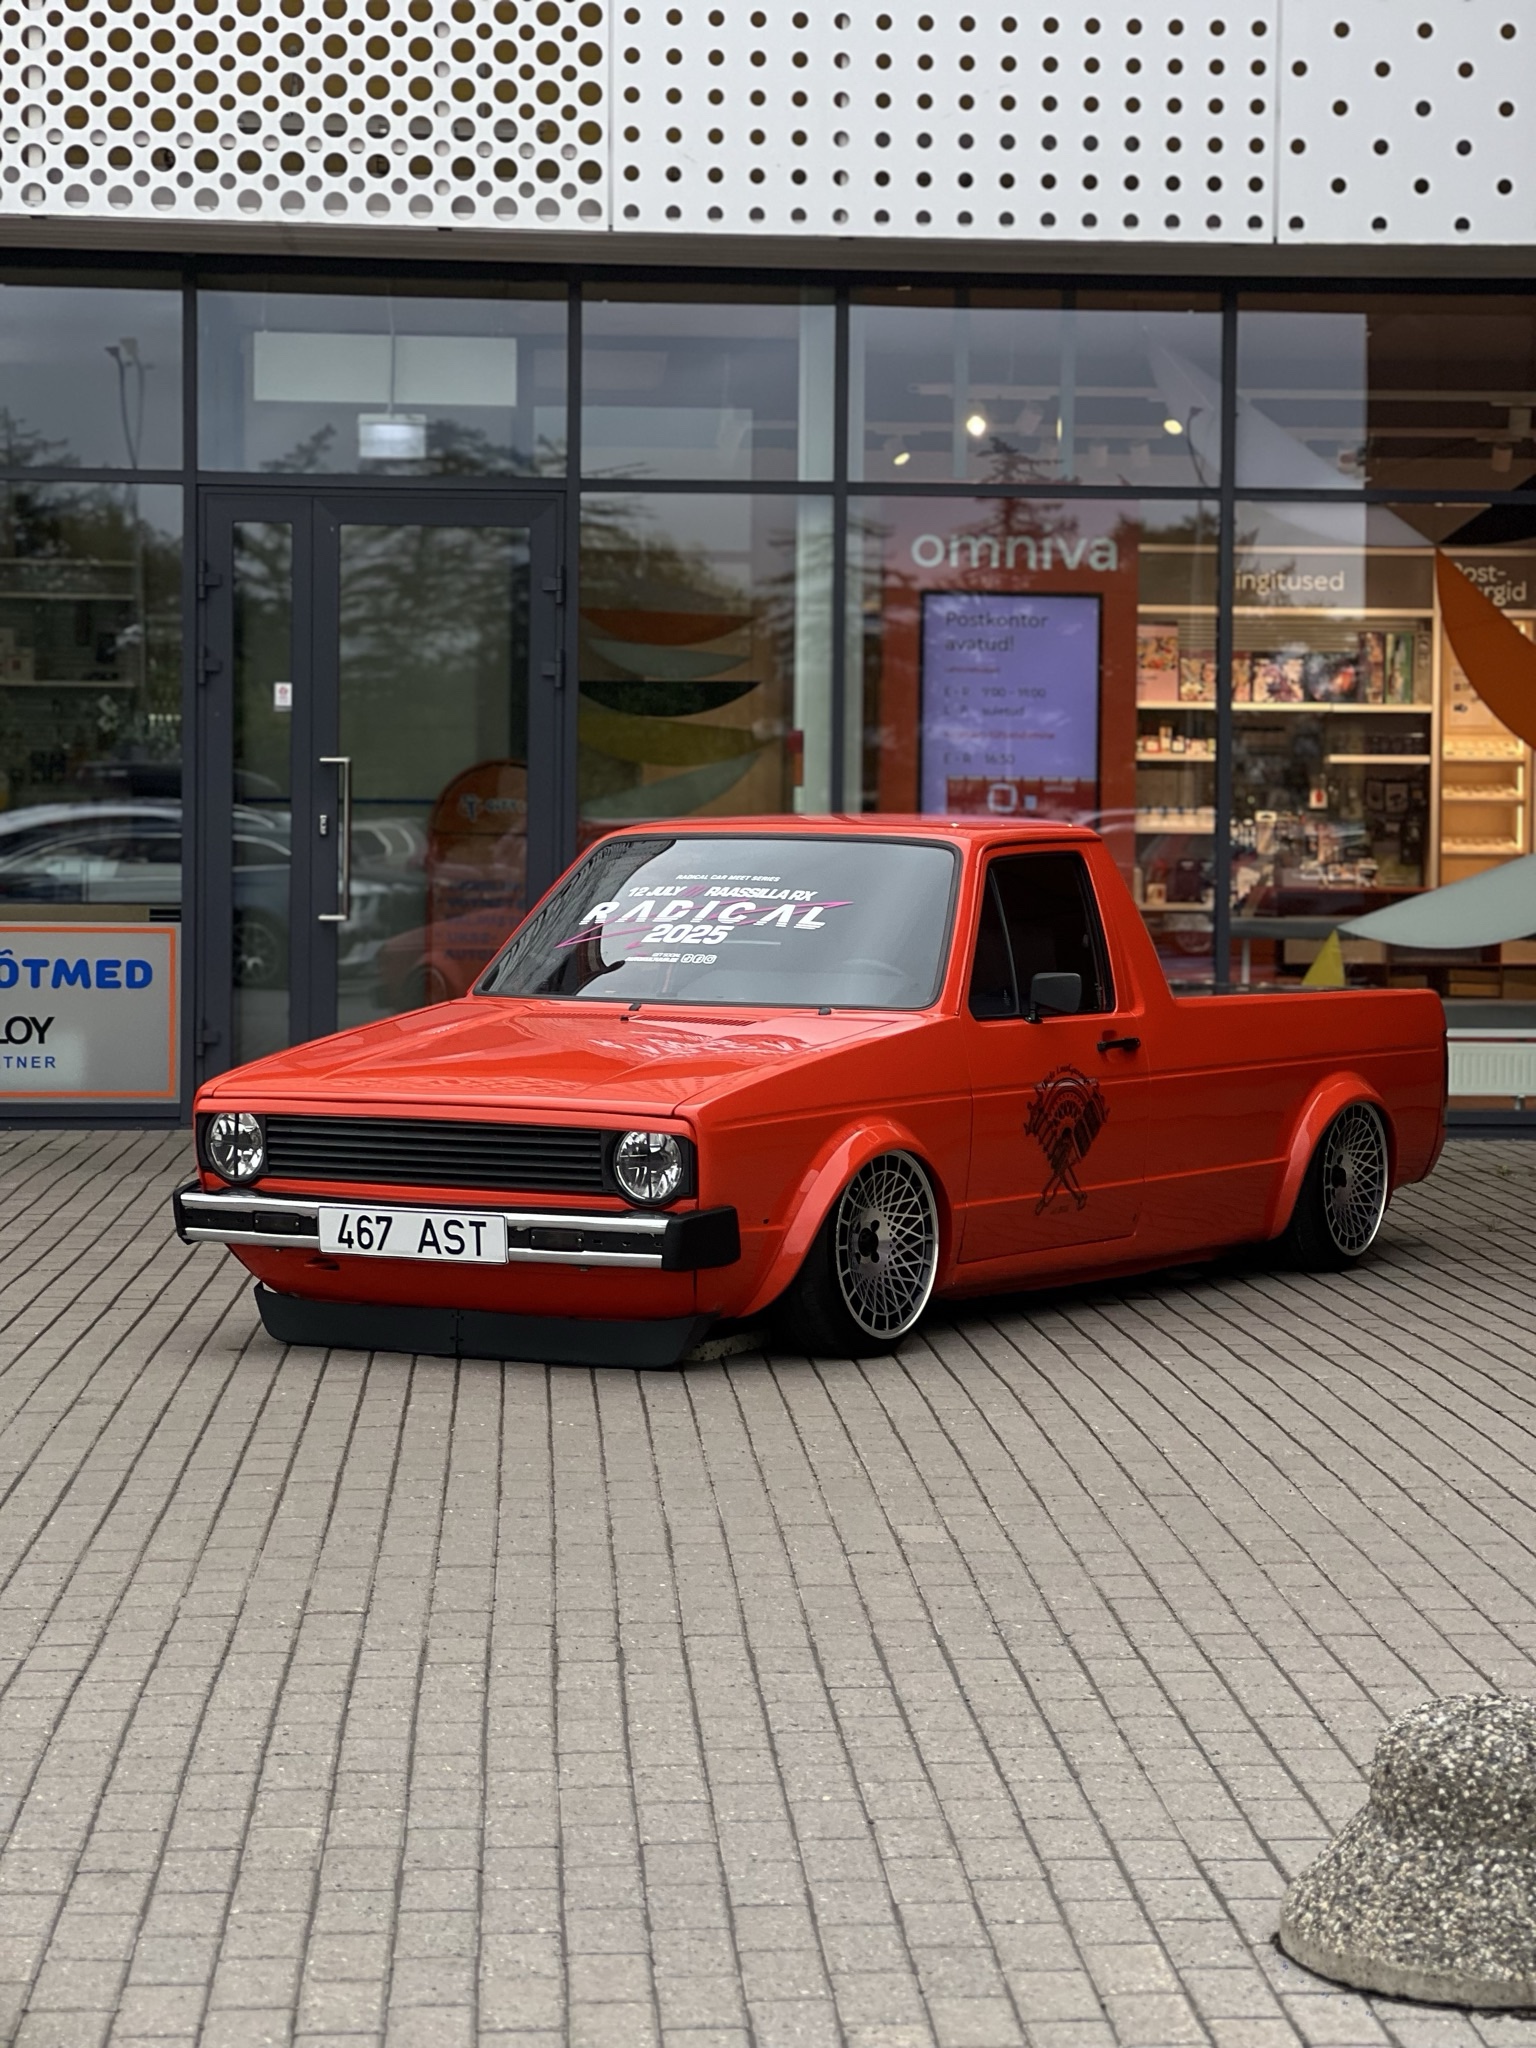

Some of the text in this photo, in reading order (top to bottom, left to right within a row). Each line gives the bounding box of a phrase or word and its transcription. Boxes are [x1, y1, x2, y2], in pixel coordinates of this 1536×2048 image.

[911, 533, 1118, 571] omniva
[1234, 569, 1344, 596] ingitused
[1478, 581, 1527, 607] rgid
[945, 611, 1048, 629] Postkontor
[944, 635, 1014, 652] avatud!
[751, 875, 781, 883] SERIES
[628, 886, 687, 898] 12 JULY
[704, 886, 818, 902] RAASSILLA RX
[579, 899, 827, 930] RADICAL
[641, 924, 735, 945] 2025
[0, 949, 153, 990] ÕTMED
[0, 1056, 57, 1069] TNER
[337, 1213, 487, 1257] 467 AST
